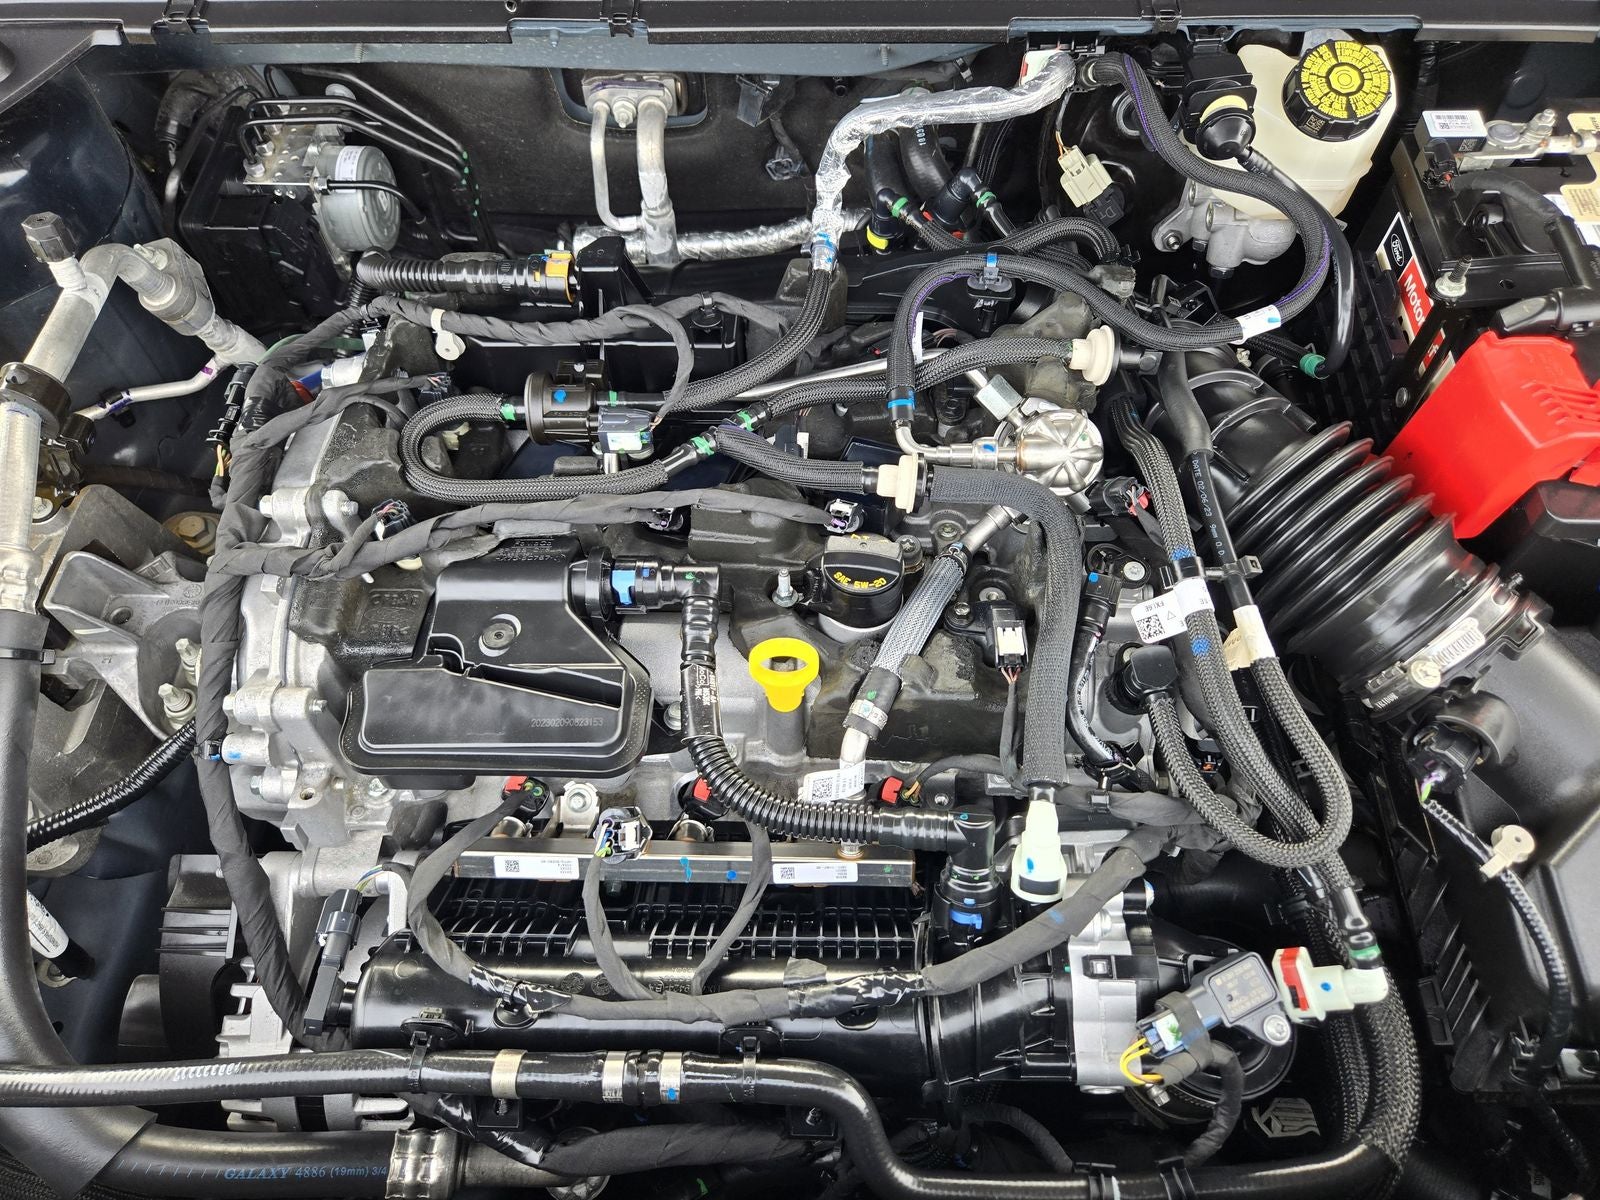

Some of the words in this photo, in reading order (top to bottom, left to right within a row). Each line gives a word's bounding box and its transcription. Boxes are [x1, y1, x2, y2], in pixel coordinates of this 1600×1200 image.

[1391, 237, 1404, 265] Ford
[1192, 459, 1202, 477] DATE
[833, 571, 851, 586] SAE
[853, 577, 887, 589] 5W-20
[223, 1167, 291, 1180] GALAXY
[295, 1165, 326, 1178] 4886
[329, 1165, 369, 1178] (19mm)
